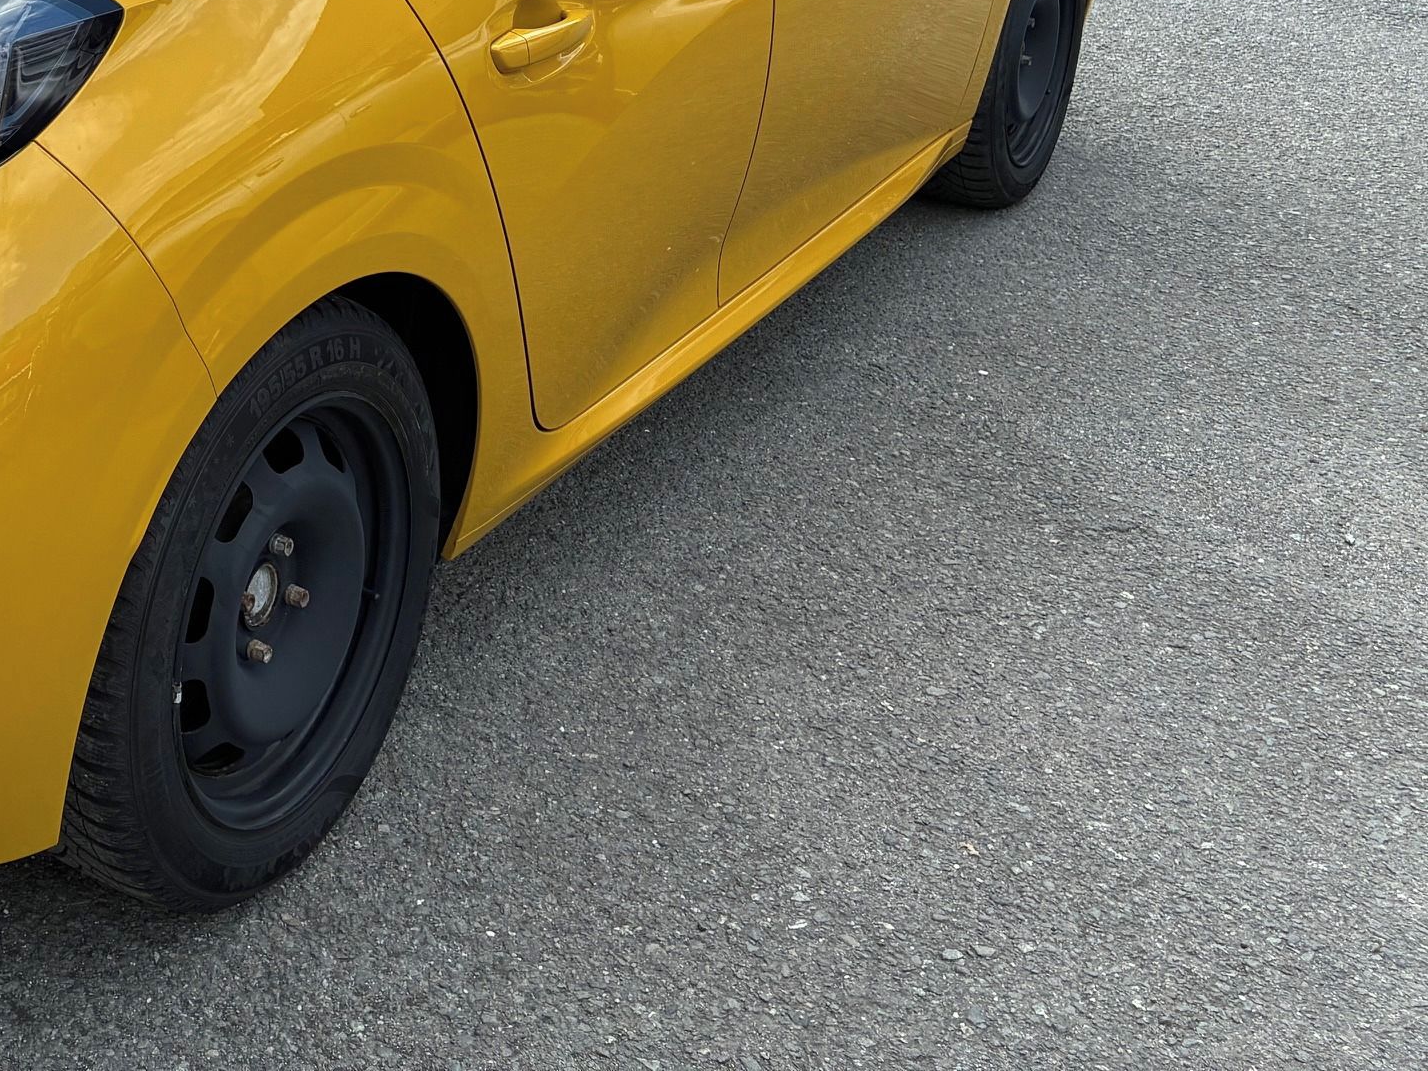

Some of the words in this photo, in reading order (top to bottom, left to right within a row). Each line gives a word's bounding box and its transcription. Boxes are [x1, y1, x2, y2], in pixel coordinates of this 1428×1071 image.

[309, 345, 323, 369] R
[326, 337, 345, 361] 16
[349, 336, 361, 359] H
